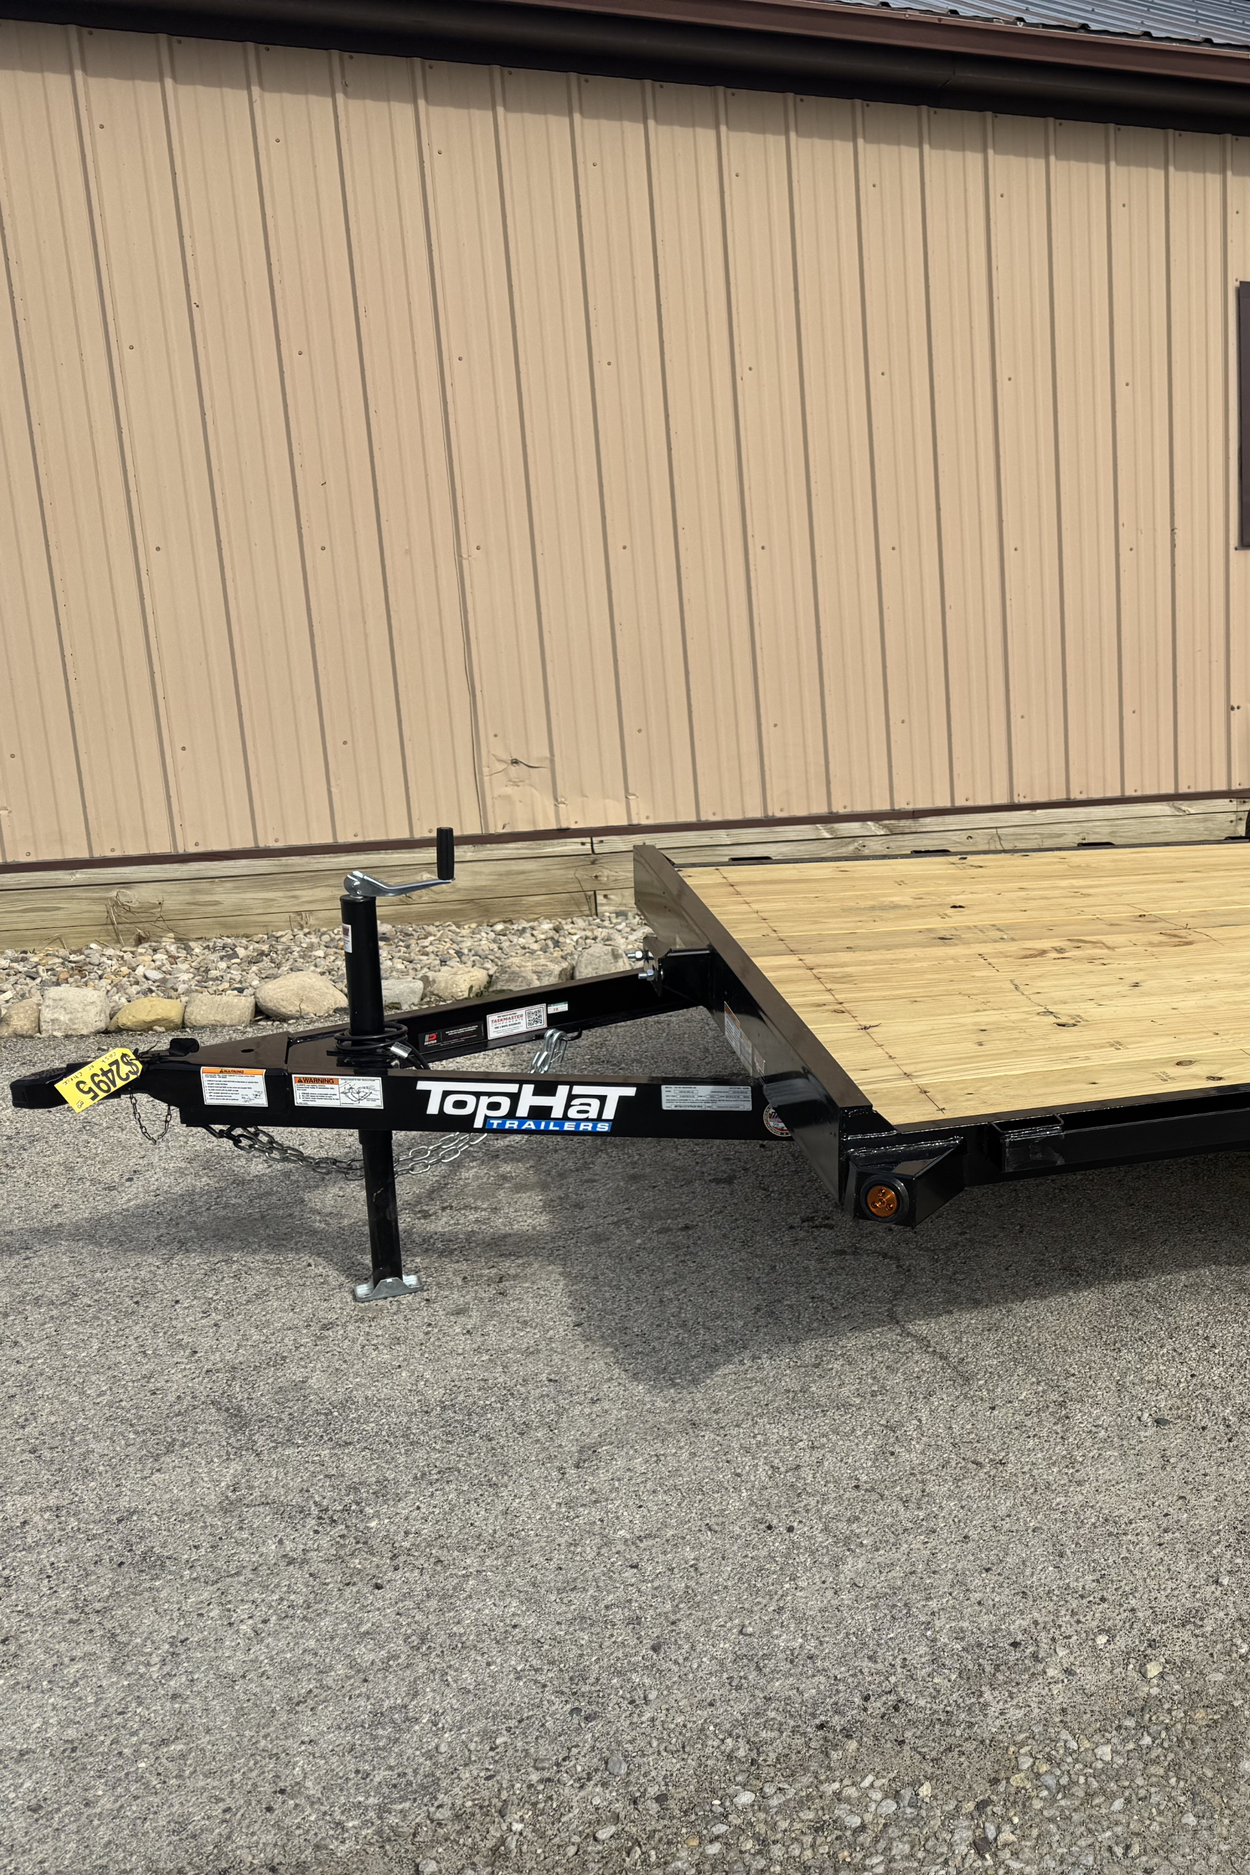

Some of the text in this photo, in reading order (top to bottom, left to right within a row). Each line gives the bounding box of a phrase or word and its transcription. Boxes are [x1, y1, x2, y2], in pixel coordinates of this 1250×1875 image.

[75, 1052, 140, 1102] $2495
[302, 1077, 335, 1085] WARNING
[489, 1120, 610, 1132] TRAILERS
